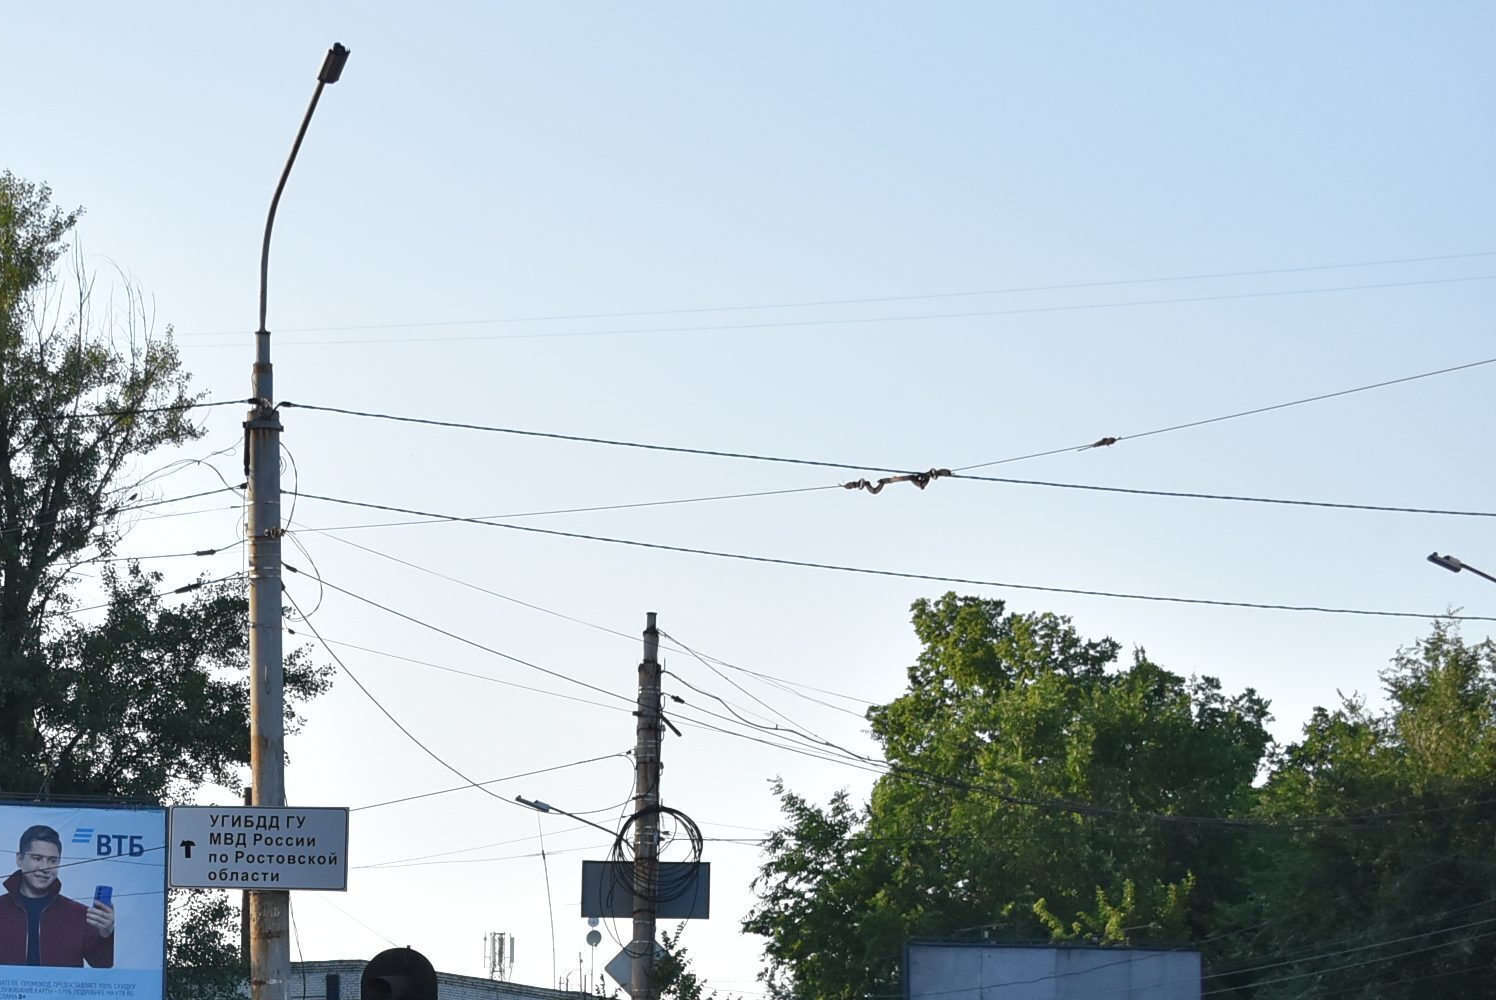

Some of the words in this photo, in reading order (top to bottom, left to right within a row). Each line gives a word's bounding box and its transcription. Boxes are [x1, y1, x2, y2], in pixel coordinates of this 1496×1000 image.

[209, 814, 280, 831] УГИБДД
[286, 815, 306, 829] ГУ
[97, 834, 144, 857] ВТБ
[209, 832, 247, 848] МВД
[253, 833, 316, 847] России
[208, 853, 229, 863] по
[235, 850, 338, 865] Ростовской
[207, 868, 280, 882] области
